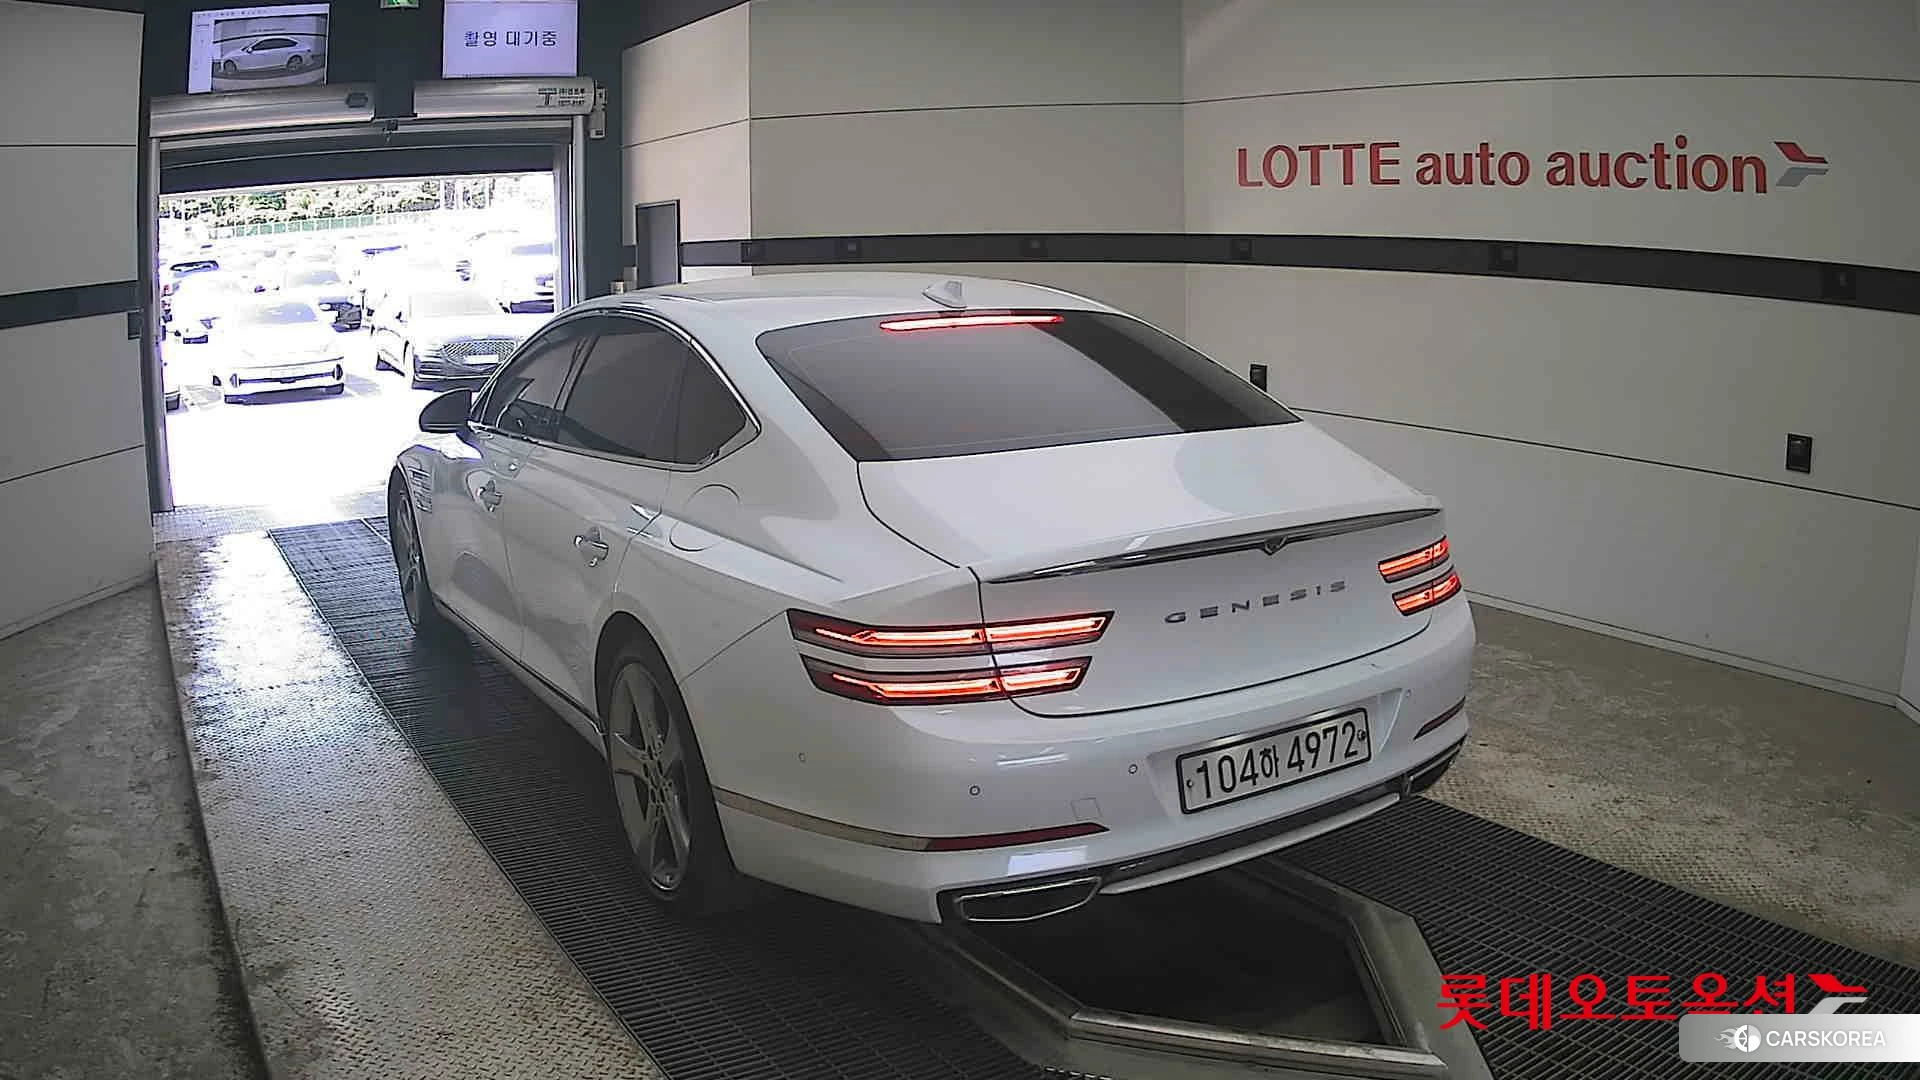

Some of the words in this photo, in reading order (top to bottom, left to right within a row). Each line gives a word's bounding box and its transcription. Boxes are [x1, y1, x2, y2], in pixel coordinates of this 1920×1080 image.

[464, 31, 497, 47] 촬영
[506, 31, 557, 46] 대기중
[1238, 141, 1401, 188] LOTTE
[1415, 141, 1530, 187] auto
[1546, 135, 1768, 194] auction
[1164, 581, 1346, 623] GENESIS
[1196, 745, 1280, 799] 104하
[1287, 721, 1359, 773] 4972
